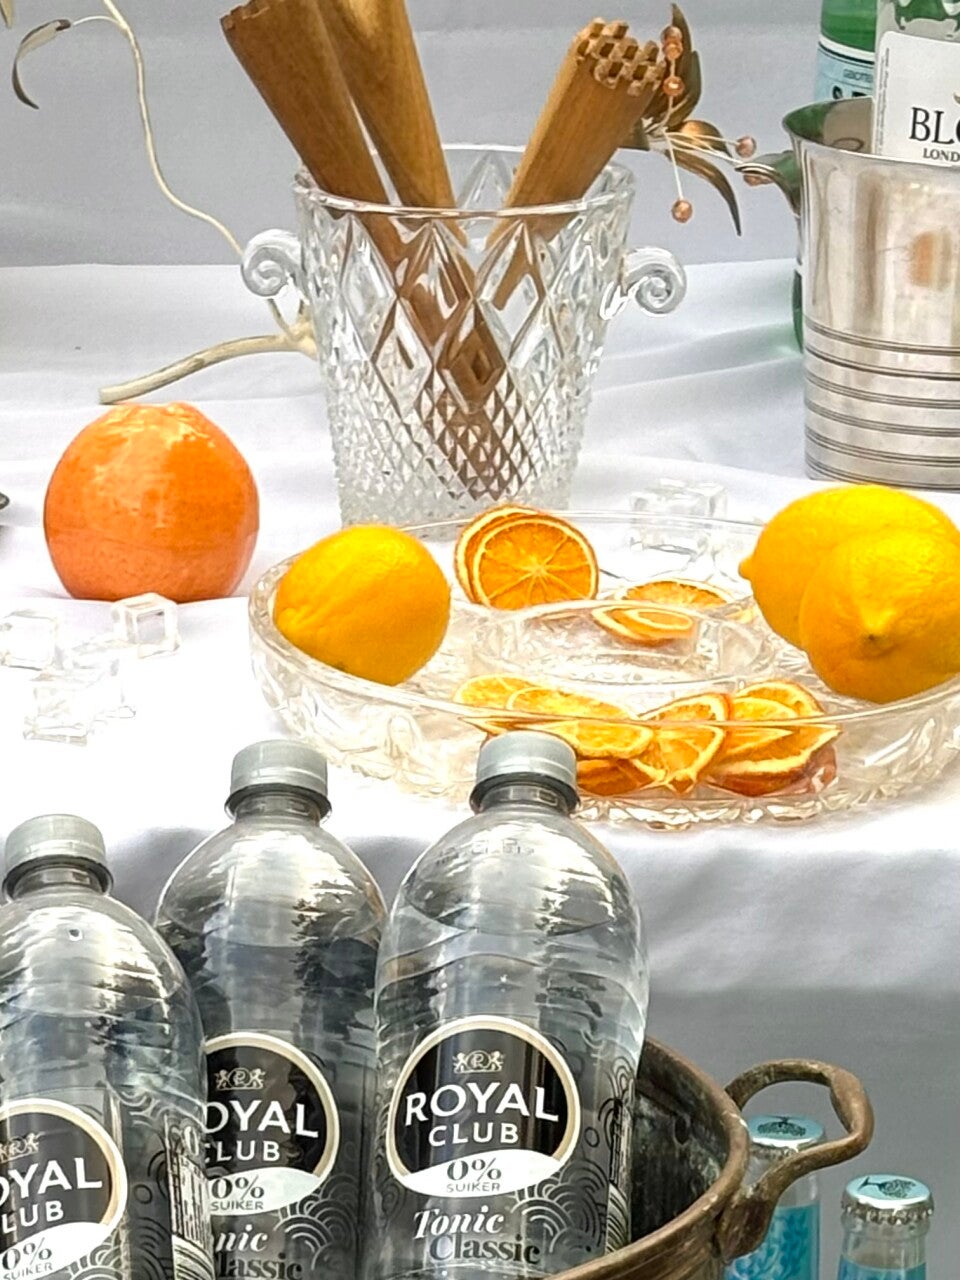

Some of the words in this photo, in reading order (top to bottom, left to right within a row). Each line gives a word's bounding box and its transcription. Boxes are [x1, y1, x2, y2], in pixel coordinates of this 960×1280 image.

[909, 106, 960, 145] BL
[404, 1081, 559, 1126] ROYAL
[205, 1099, 319, 1138] OYAL
[428, 1122, 520, 1147] CLUB
[204, 1139, 281, 1162] LUB
[446, 1157, 502, 1182] 0%
[211, 1174, 265, 1200] 0%
[446, 1181, 501, 1193] SUIKER
[211, 1199, 264, 1212] SUIKER
[413, 1205, 505, 1240] Tonic
[215, 1223, 269, 1252] nic
[429, 1234, 540, 1265] Classic
[1, 1237, 53, 1271] 0%
